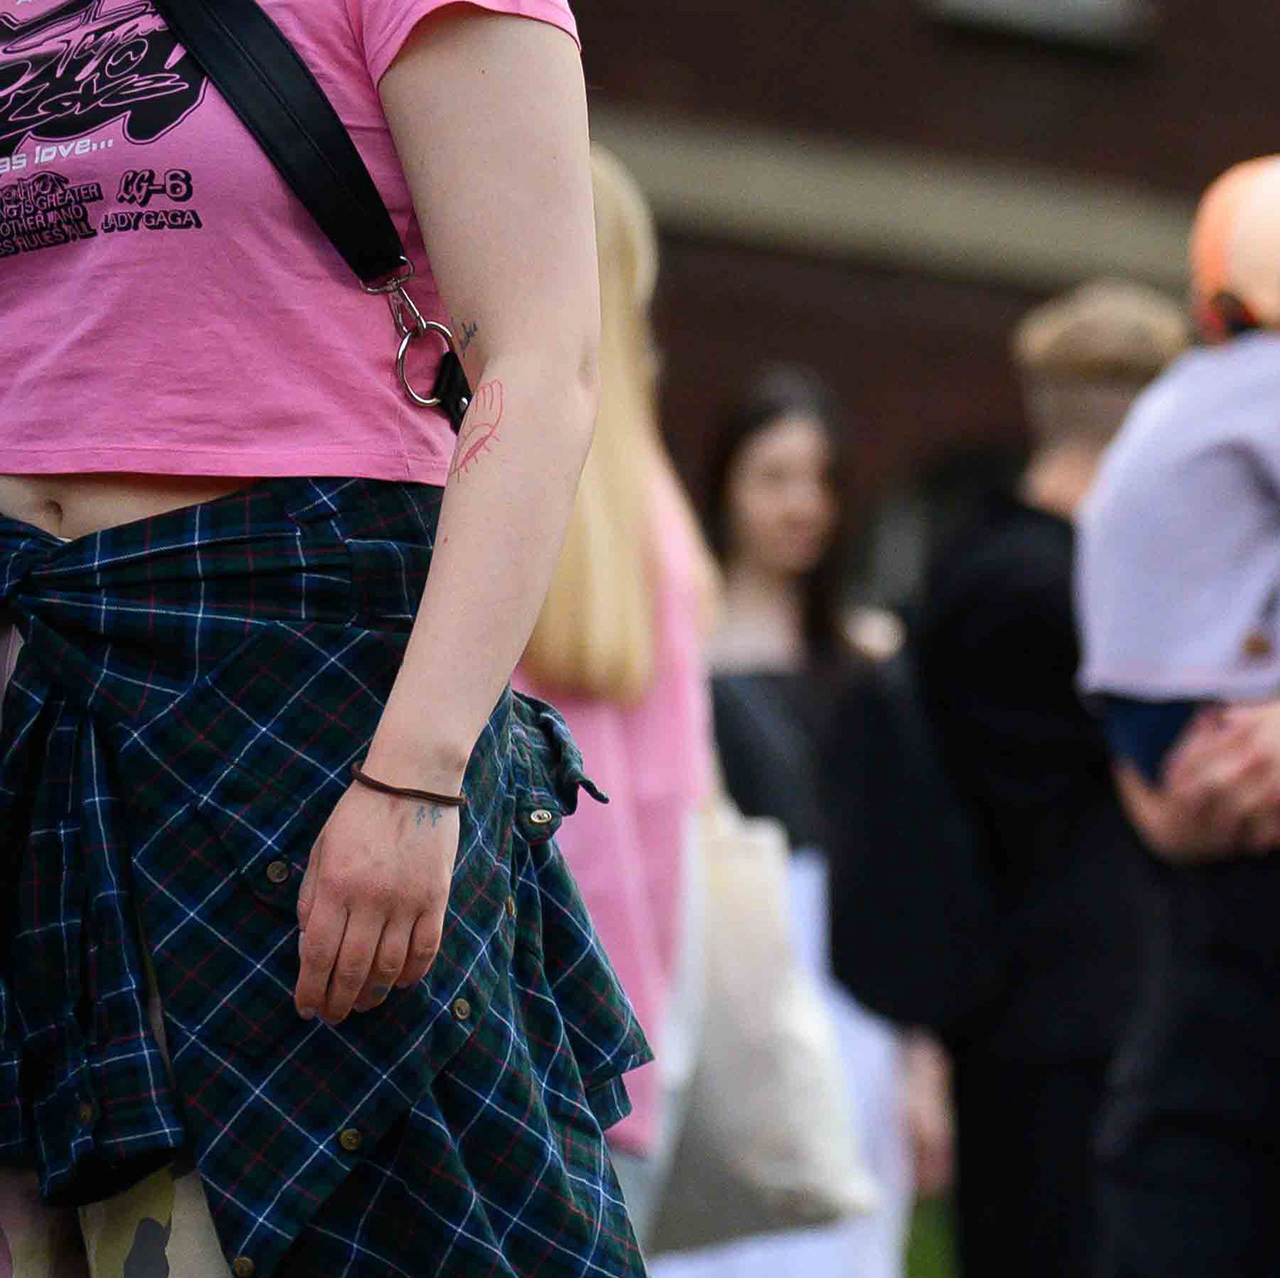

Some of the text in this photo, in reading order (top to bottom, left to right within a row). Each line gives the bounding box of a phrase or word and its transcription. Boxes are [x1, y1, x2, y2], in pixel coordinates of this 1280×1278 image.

[34, 138, 114, 165] love...
[36, 183, 100, 211] GREATER
[102, 210, 200, 233] LADY GAGA
